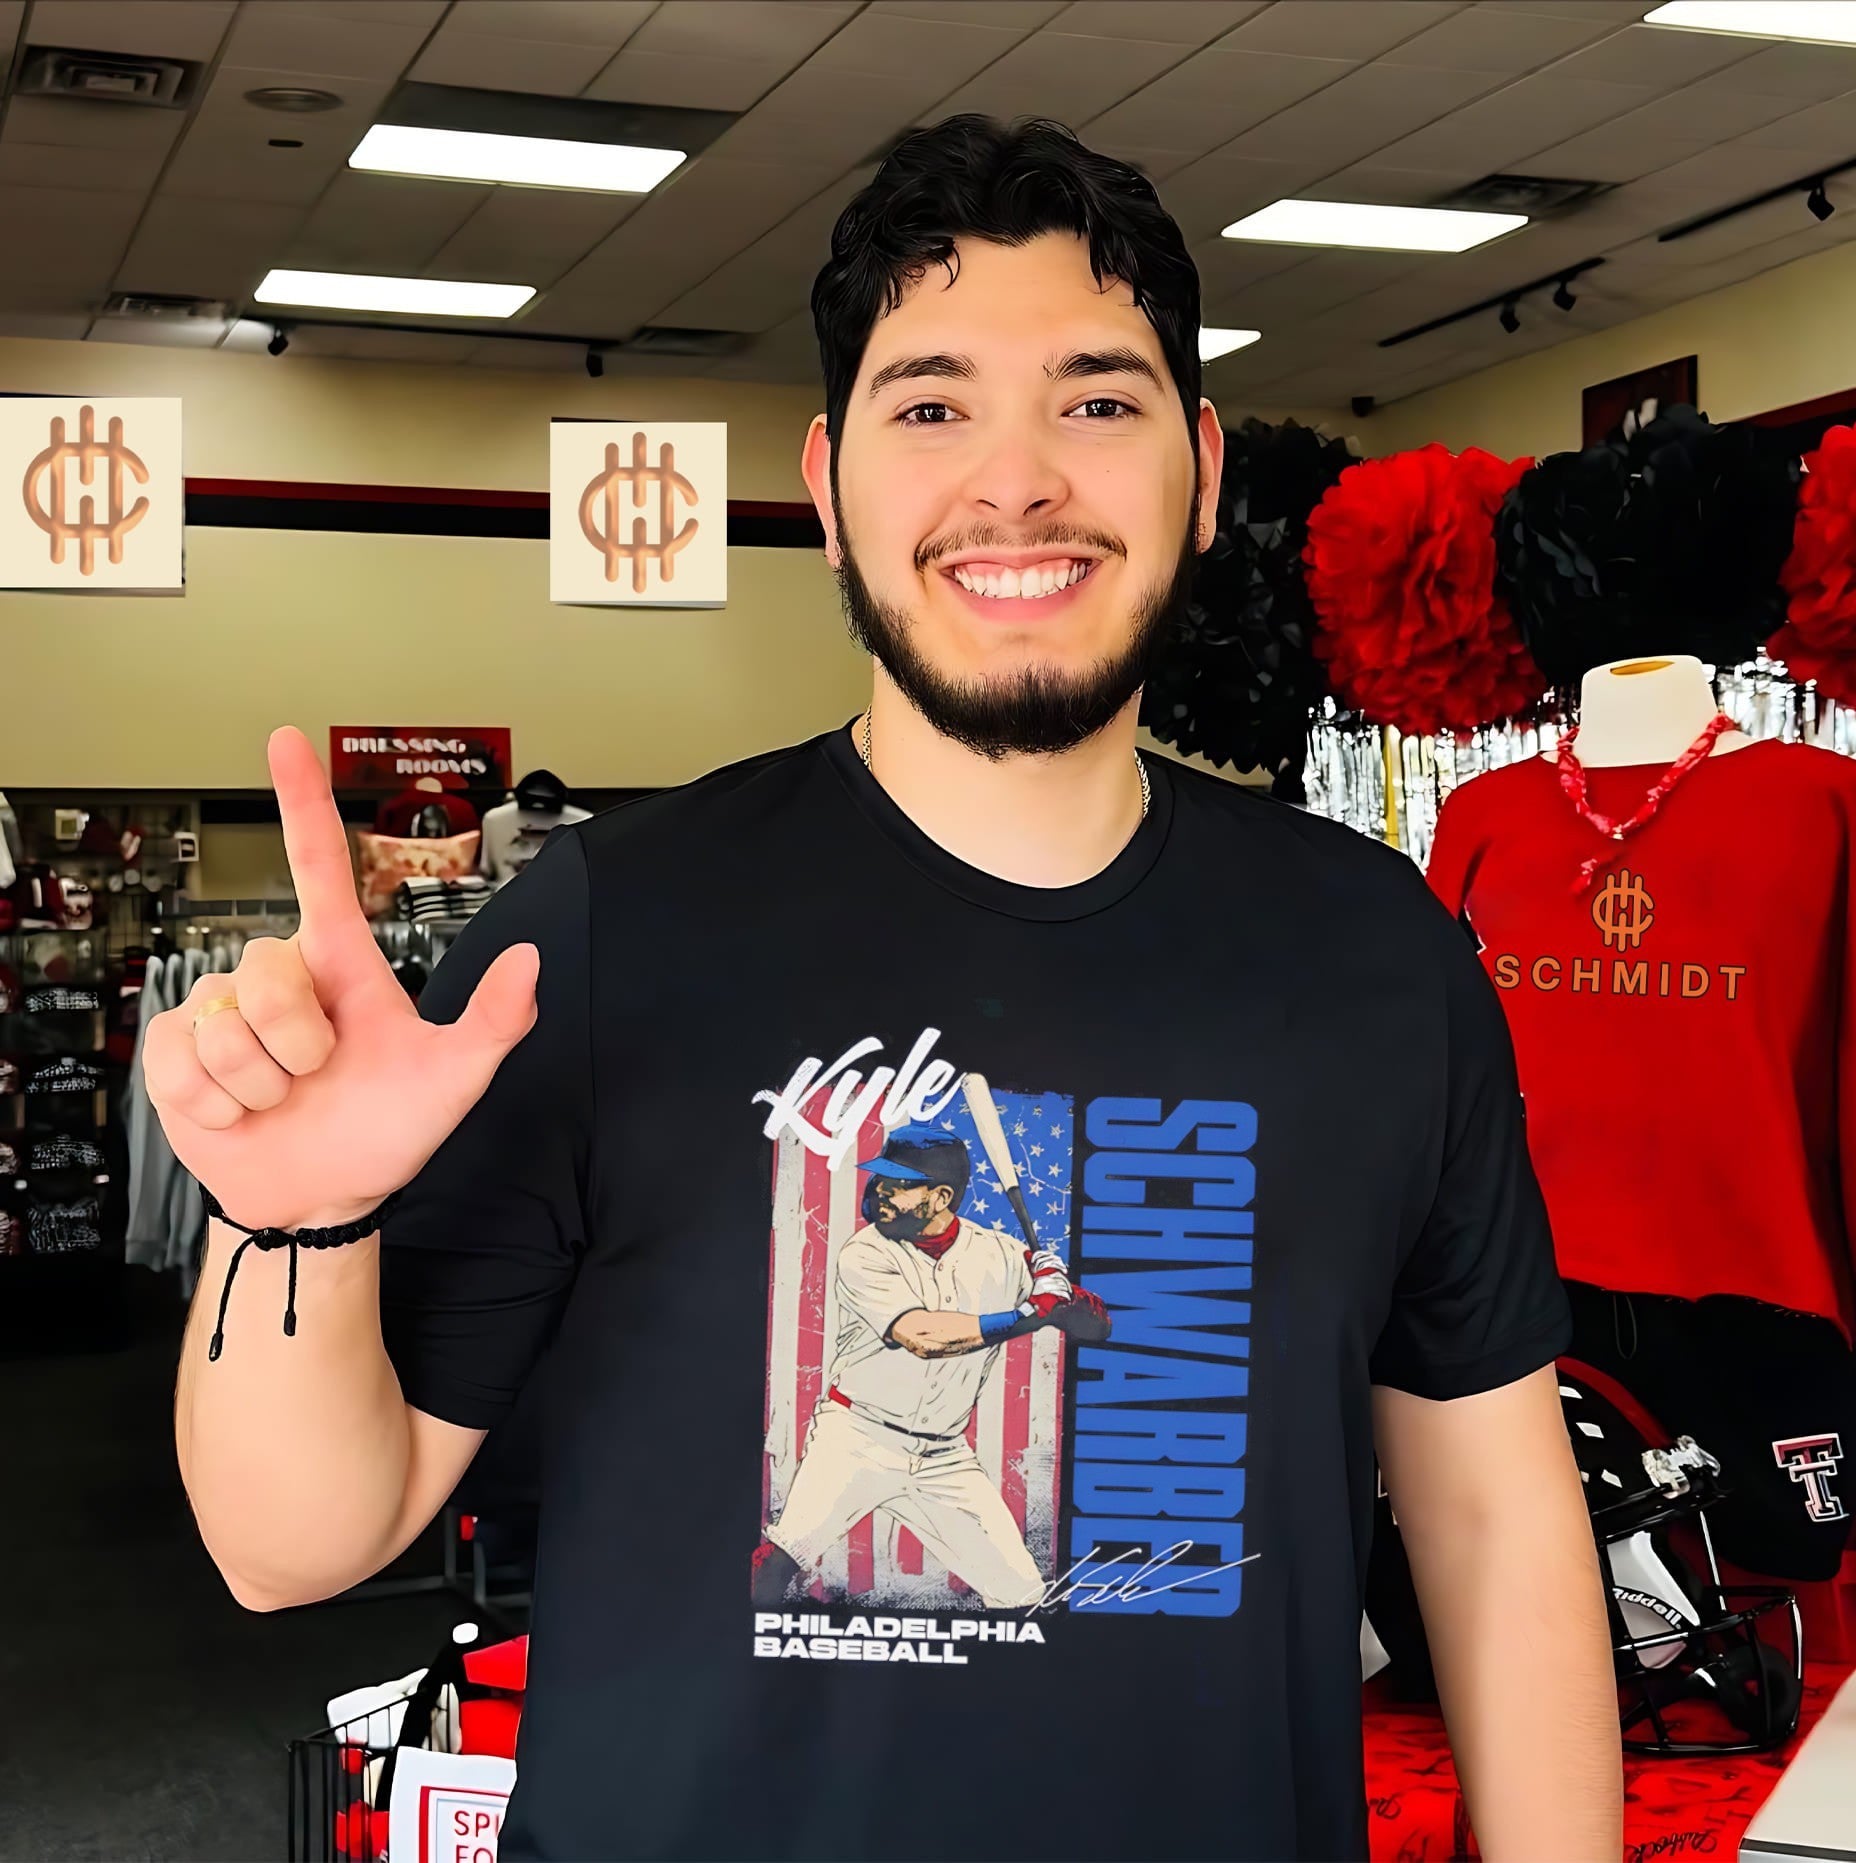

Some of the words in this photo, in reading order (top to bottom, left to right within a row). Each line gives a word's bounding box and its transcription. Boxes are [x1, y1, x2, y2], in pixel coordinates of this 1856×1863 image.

[396, 758, 487, 774] ROOMS
[1494, 954, 1747, 1001] SCHMIDT
[752, 1027, 967, 1172] Kyle
[1068, 1096, 1259, 1618] SCHWARBER
[755, 1613, 1046, 1643] PHILADELPHIA
[754, 1636, 968, 1664] BASEBALL
